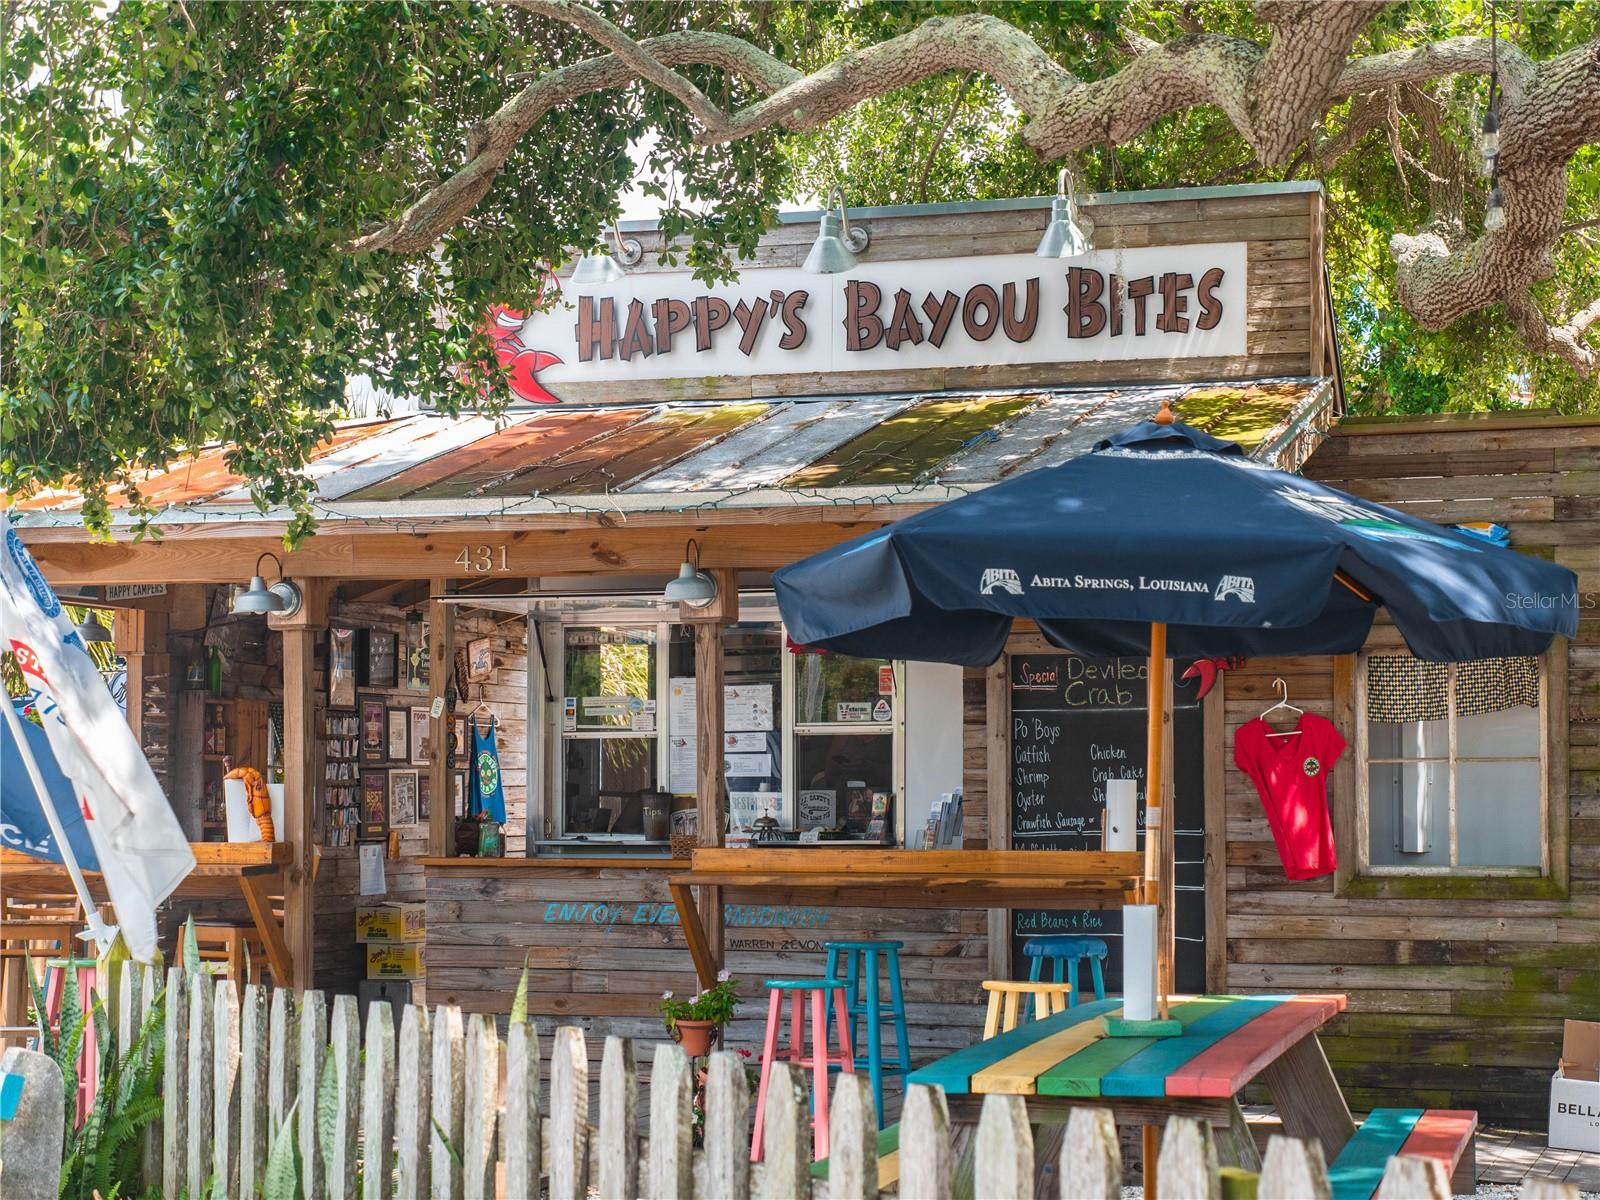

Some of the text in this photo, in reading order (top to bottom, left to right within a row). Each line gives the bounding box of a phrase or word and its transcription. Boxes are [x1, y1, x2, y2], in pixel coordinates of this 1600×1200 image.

[575, 266, 1225, 363] HAPPY'S BAYOU BITES
[455, 545, 510, 572] 431
[109, 583, 164, 598] HAPPY CAMPERS
[1020, 662, 1059, 691] Special
[1065, 681, 1133, 706] Crab
[1015, 744, 1051, 764] Catfish
[1091, 743, 1127, 760] Chicken
[1016, 767, 1050, 787] Shrimp
[1092, 765, 1145, 783] Crab Cake
[1016, 790, 1046, 812] Oyster
[642, 806, 662, 819] Tips
[1017, 815, 1052, 831] Crawfish
[1055, 812, 1086, 832] Sausage
[543, 903, 623, 934] ENJOY
[1017, 911, 1037, 929] Red
[1041, 911, 1068, 929] Beans
[1082, 909, 1103, 929] Rice
[730, 938, 824, 952] WARREN ZEVON
